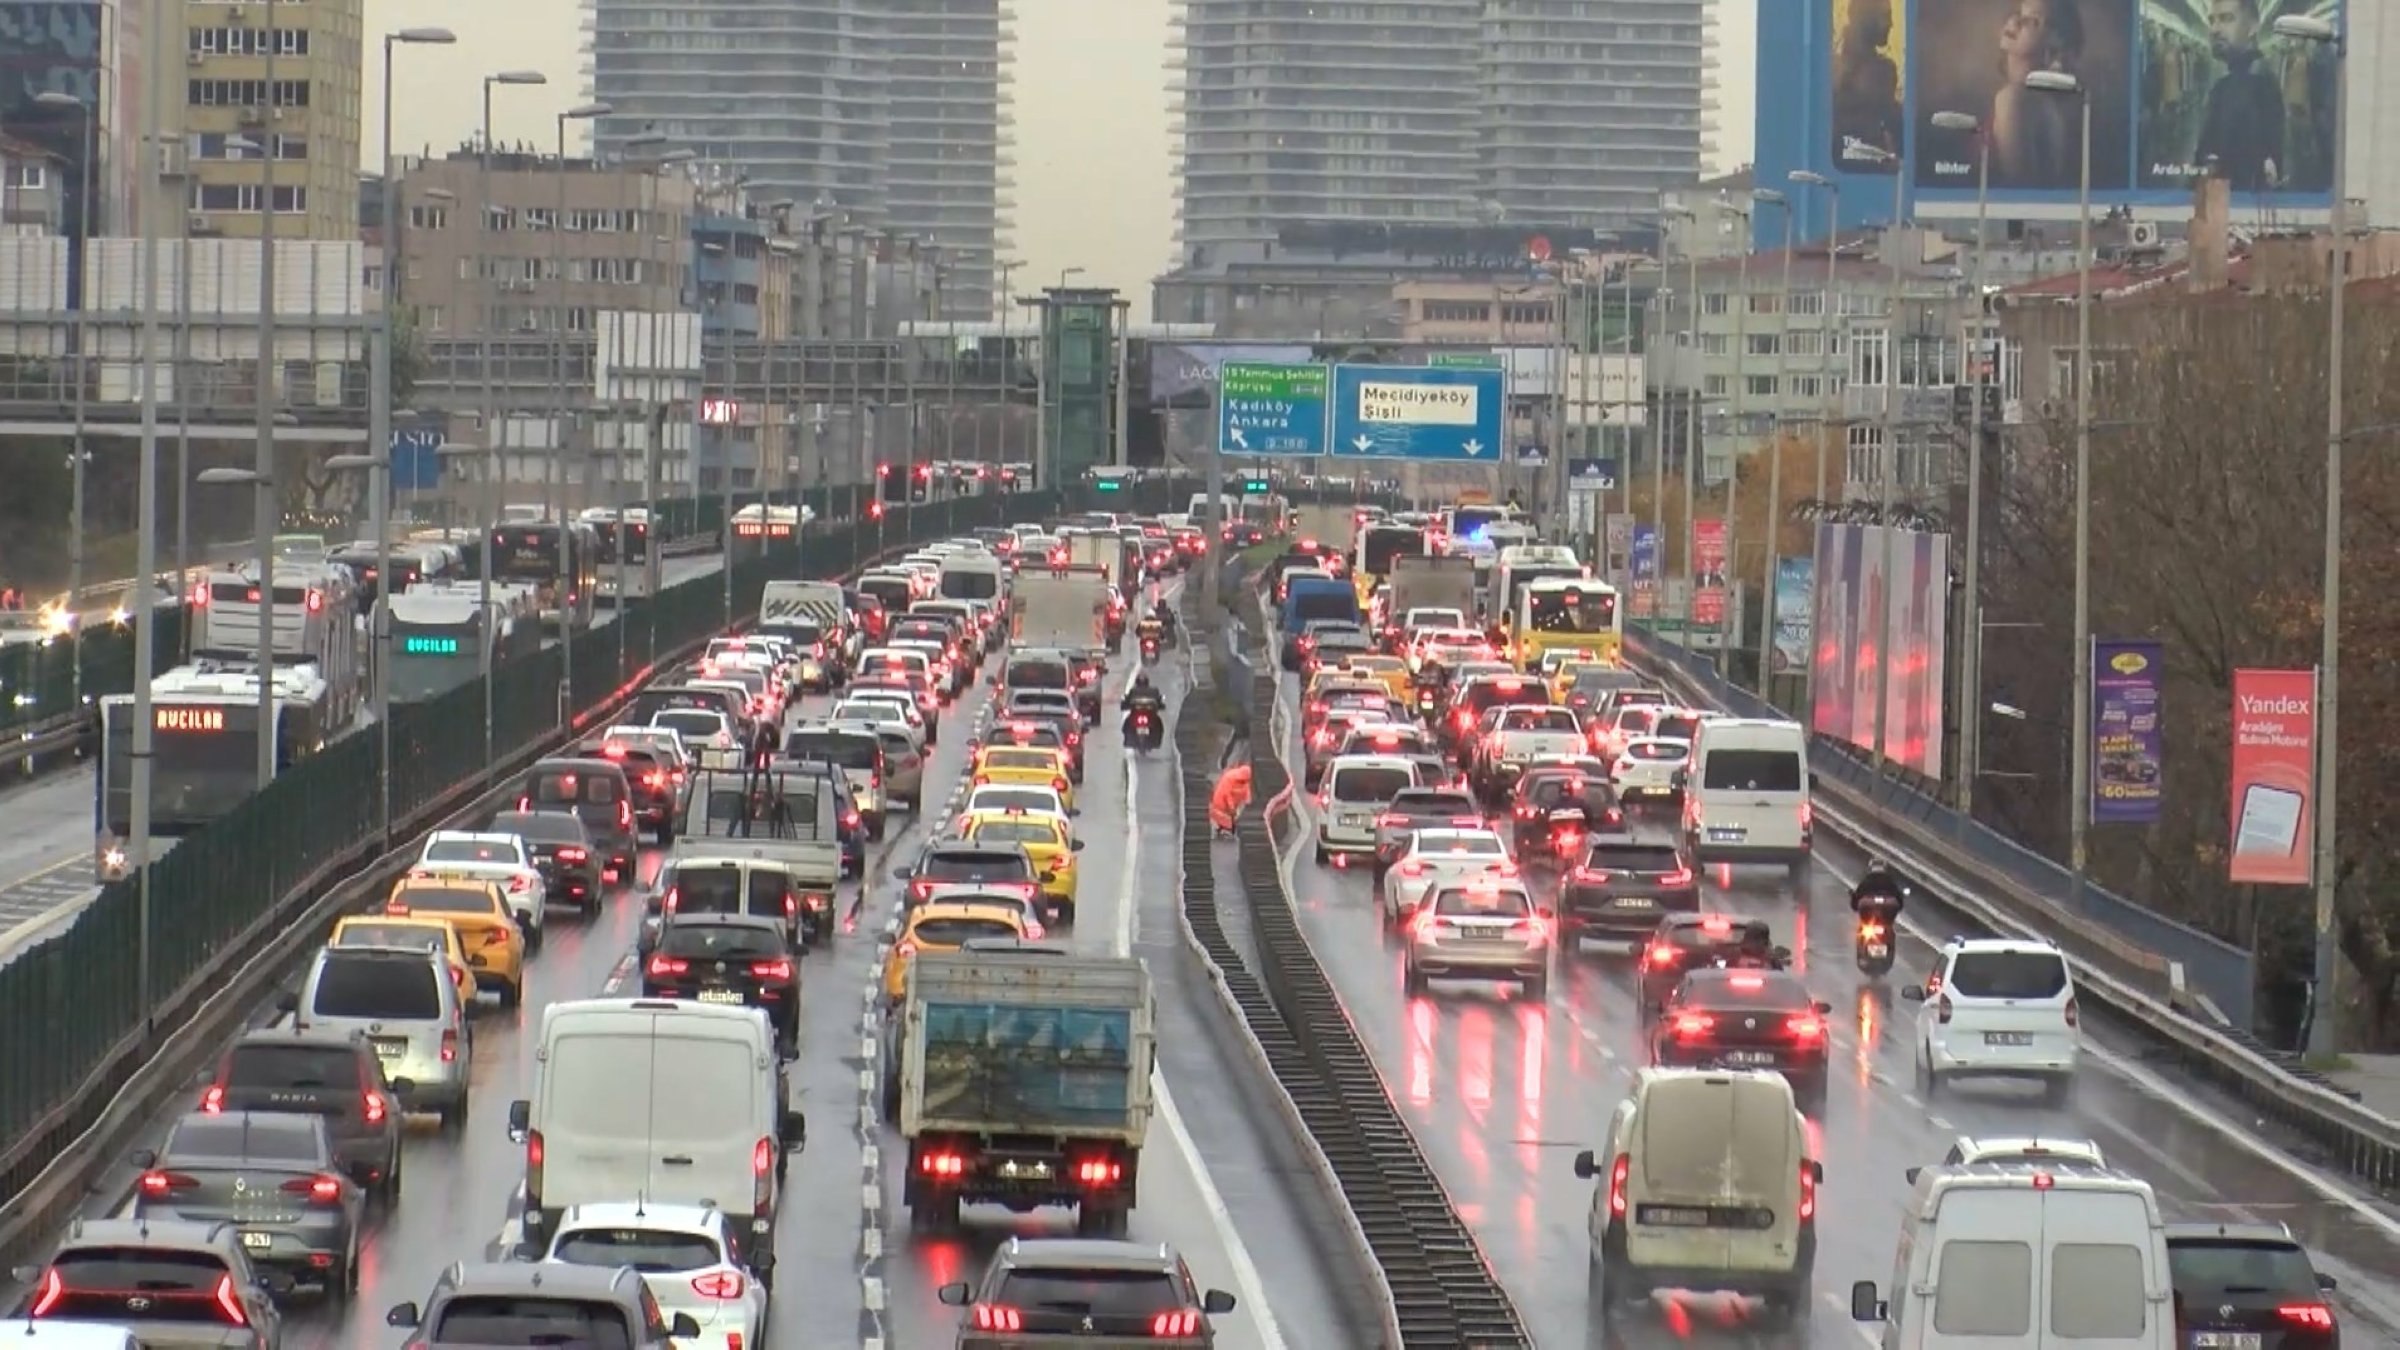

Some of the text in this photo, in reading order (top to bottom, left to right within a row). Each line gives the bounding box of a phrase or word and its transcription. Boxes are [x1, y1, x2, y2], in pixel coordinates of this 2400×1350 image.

[1240, 366, 1284, 380] Temmuz
[1364, 387, 1470, 407] Mecidiyeköy
[1229, 398, 1293, 415] Kadıköy
[1364, 403, 1401, 419] Şişli
[1230, 413, 1288, 428] Ankara
[2240, 694, 2309, 715] Yandex
